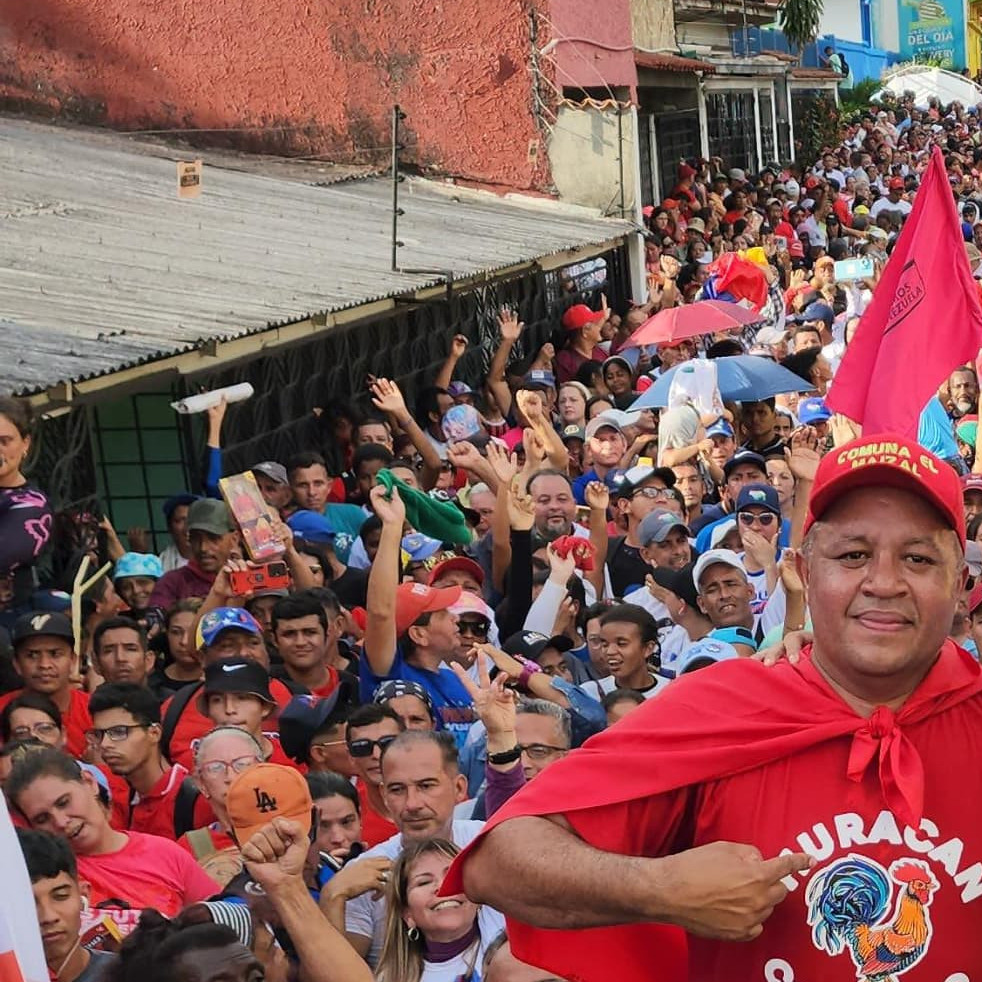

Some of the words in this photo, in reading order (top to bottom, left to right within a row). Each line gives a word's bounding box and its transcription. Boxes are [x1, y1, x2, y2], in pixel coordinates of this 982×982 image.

[888, 286, 923, 320] EZUELA
[838, 442, 911, 465] COMUNA
[919, 454, 939, 474] EL
[253, 787, 278, 813] LA
